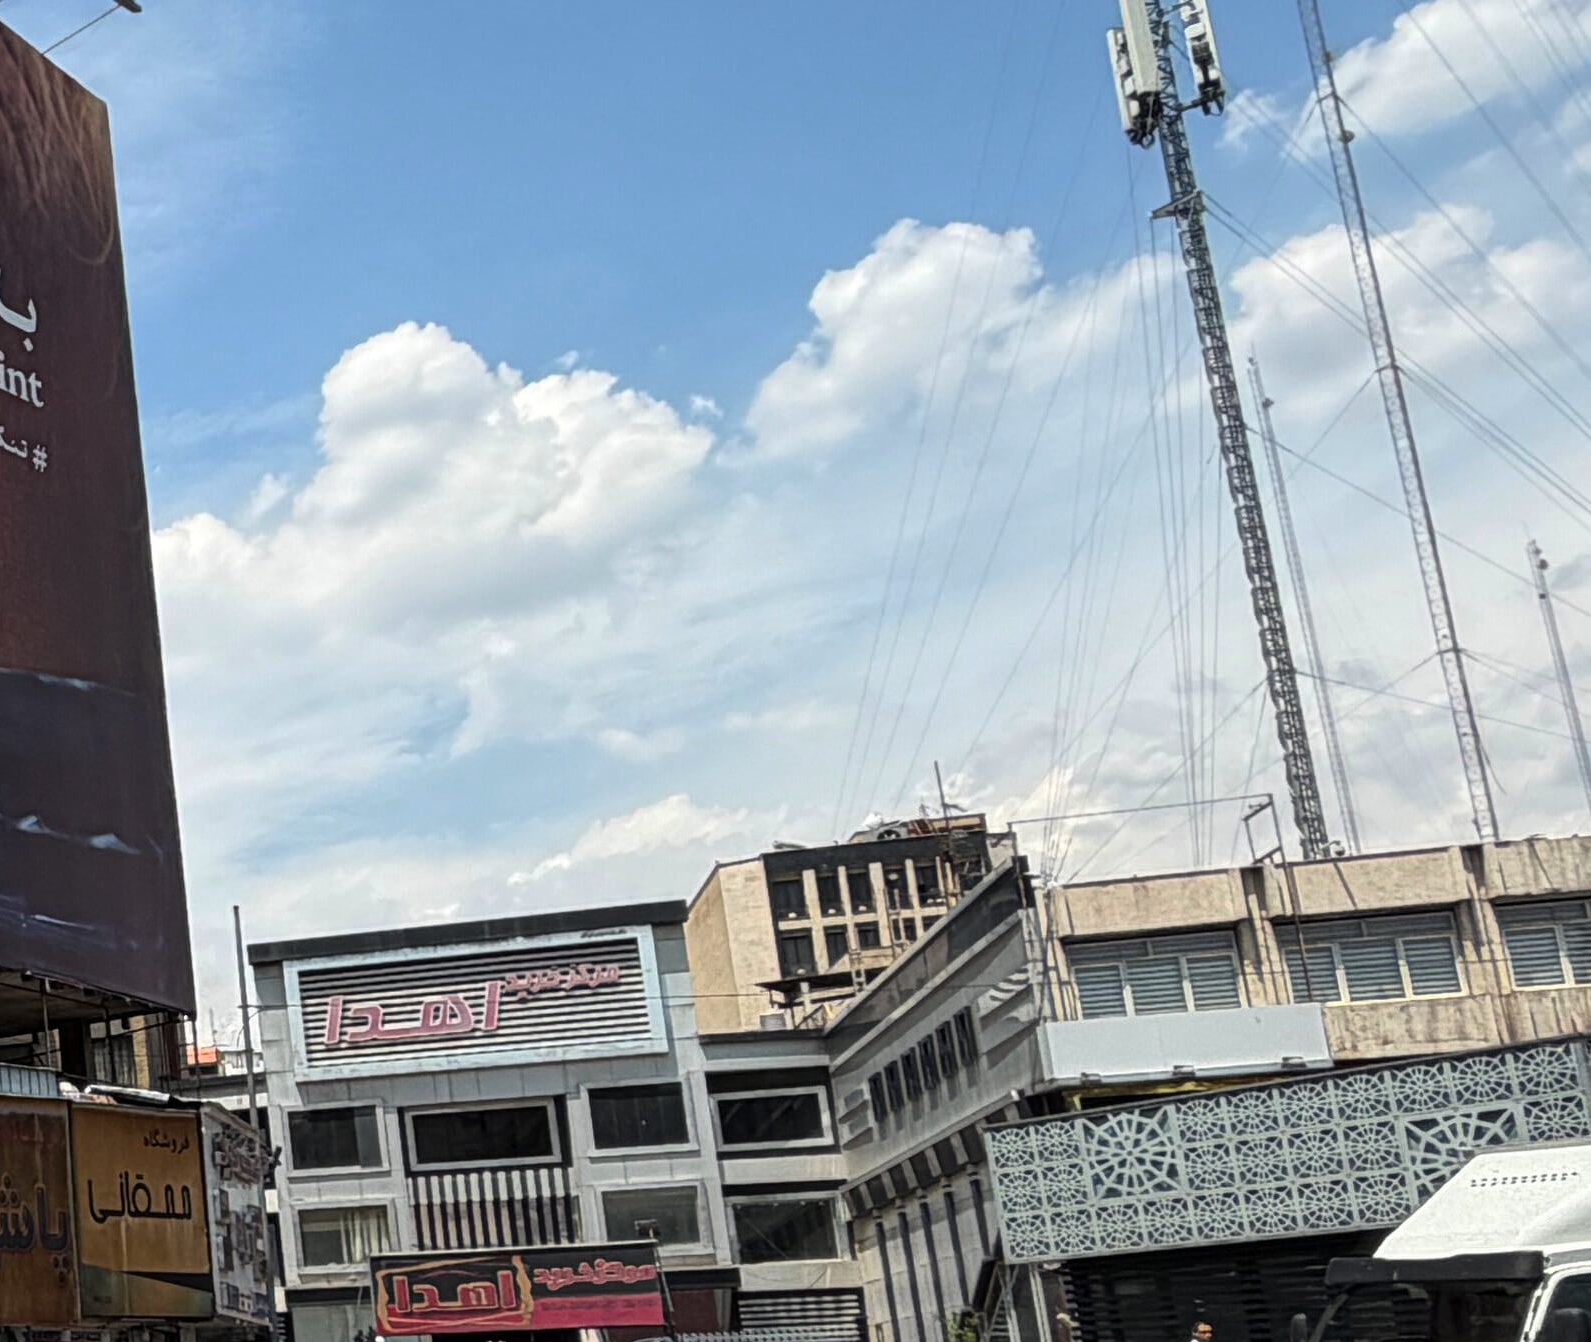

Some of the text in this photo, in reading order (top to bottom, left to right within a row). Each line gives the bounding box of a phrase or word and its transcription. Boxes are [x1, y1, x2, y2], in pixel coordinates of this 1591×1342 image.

[324, 980, 501, 1046] اهدا
[143, 1129, 190, 1154] فروشگاه
[393, 1269, 517, 1314] اهدا
